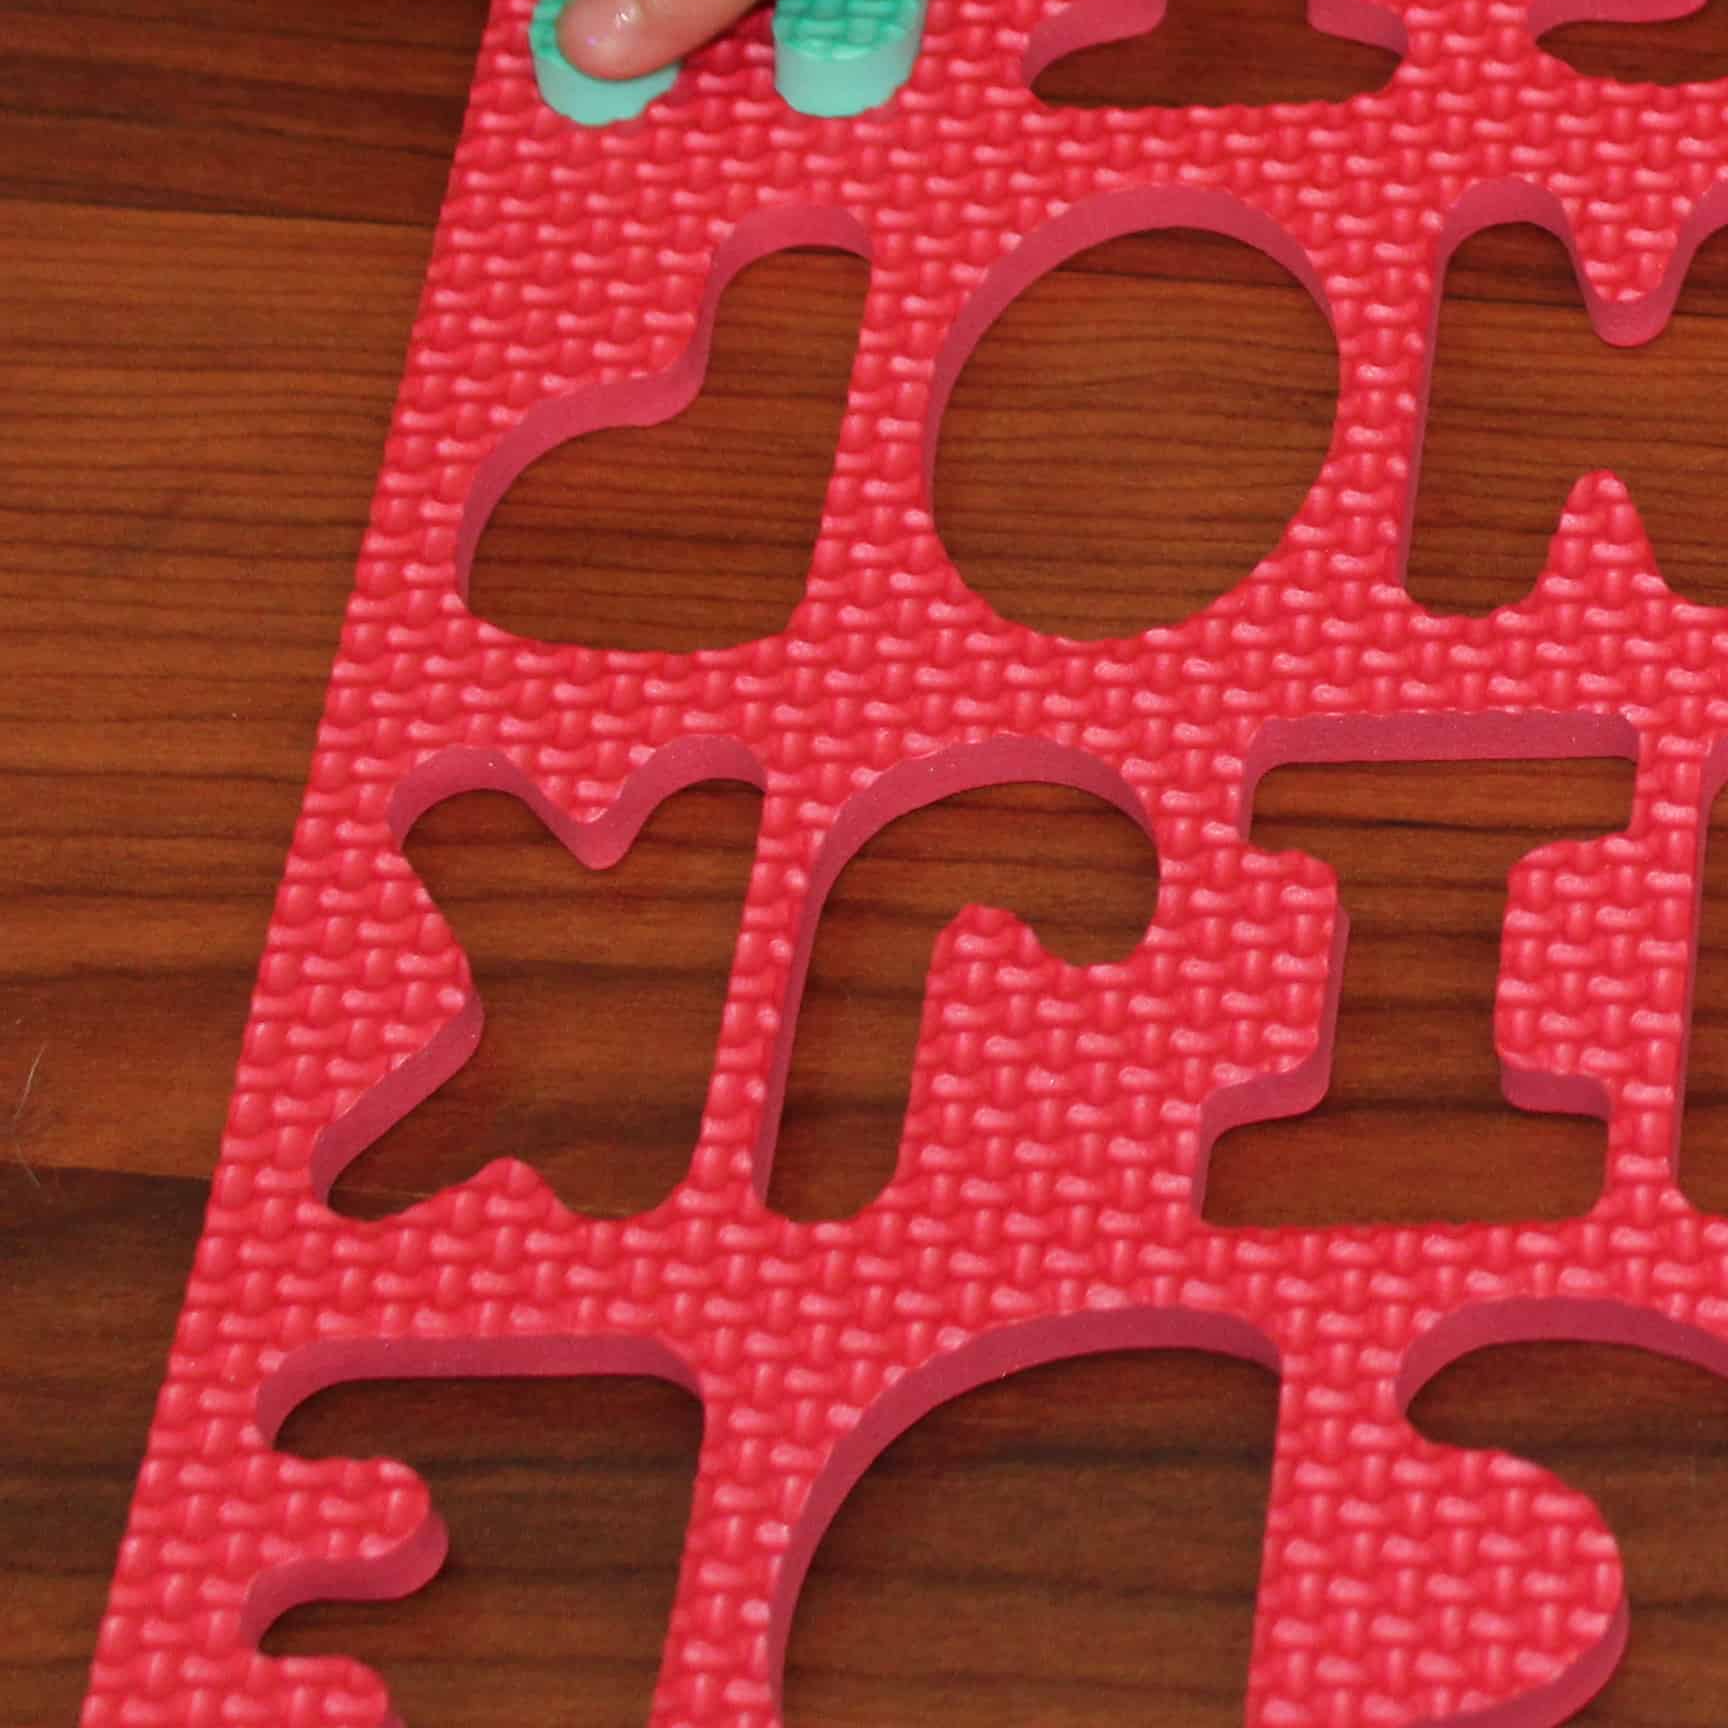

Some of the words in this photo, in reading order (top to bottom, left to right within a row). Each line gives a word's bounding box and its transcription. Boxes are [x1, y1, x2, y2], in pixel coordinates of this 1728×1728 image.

[457, 207, 873, 652] P
[922, 187, 1342, 642] O
[312, 739, 765, 1217] K
[762, 739, 1162, 1222] J
[1200, 712, 1642, 1227] I
[255, 1337, 705, 1728] E
